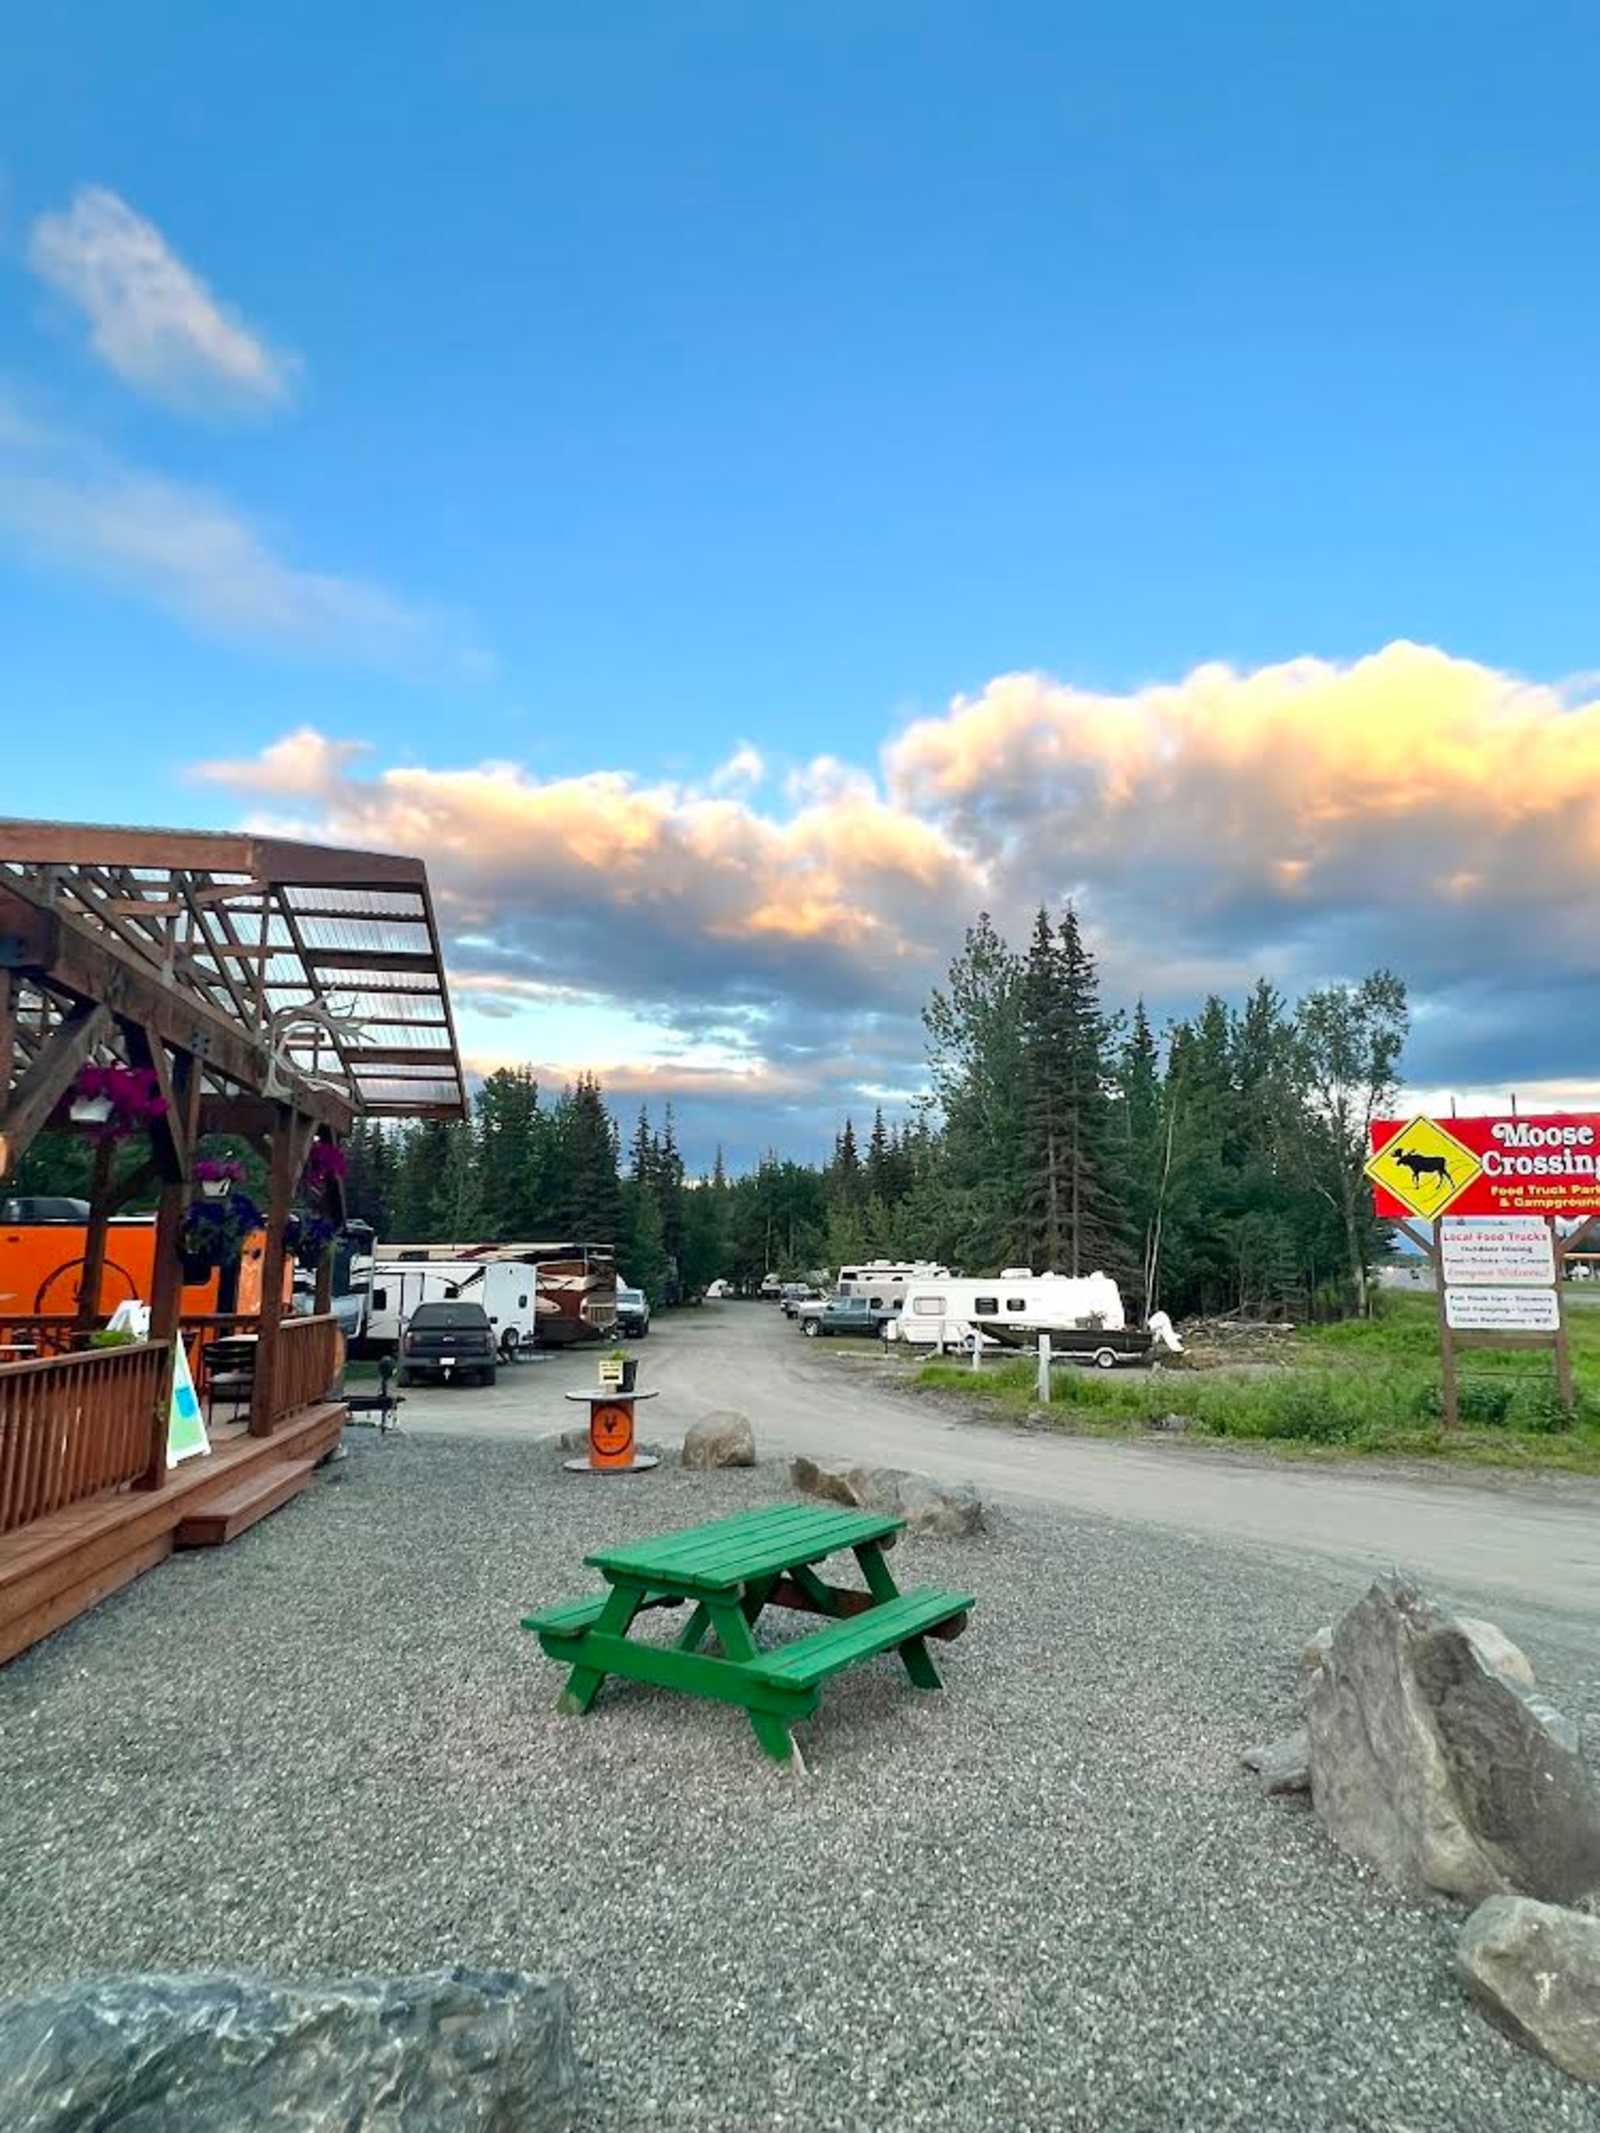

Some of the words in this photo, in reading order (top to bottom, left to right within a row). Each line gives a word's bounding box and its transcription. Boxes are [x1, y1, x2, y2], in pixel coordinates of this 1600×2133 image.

[1491, 1122, 1594, 1147] Moose
[1490, 1185, 1524, 1196] Food
[1527, 1185, 1567, 1195] Truck
[1499, 1197, 1511, 1208] &
[1444, 1231, 1473, 1241] Local
[1476, 1232, 1505, 1241] Food
[1508, 1231, 1548, 1241] Trucks
